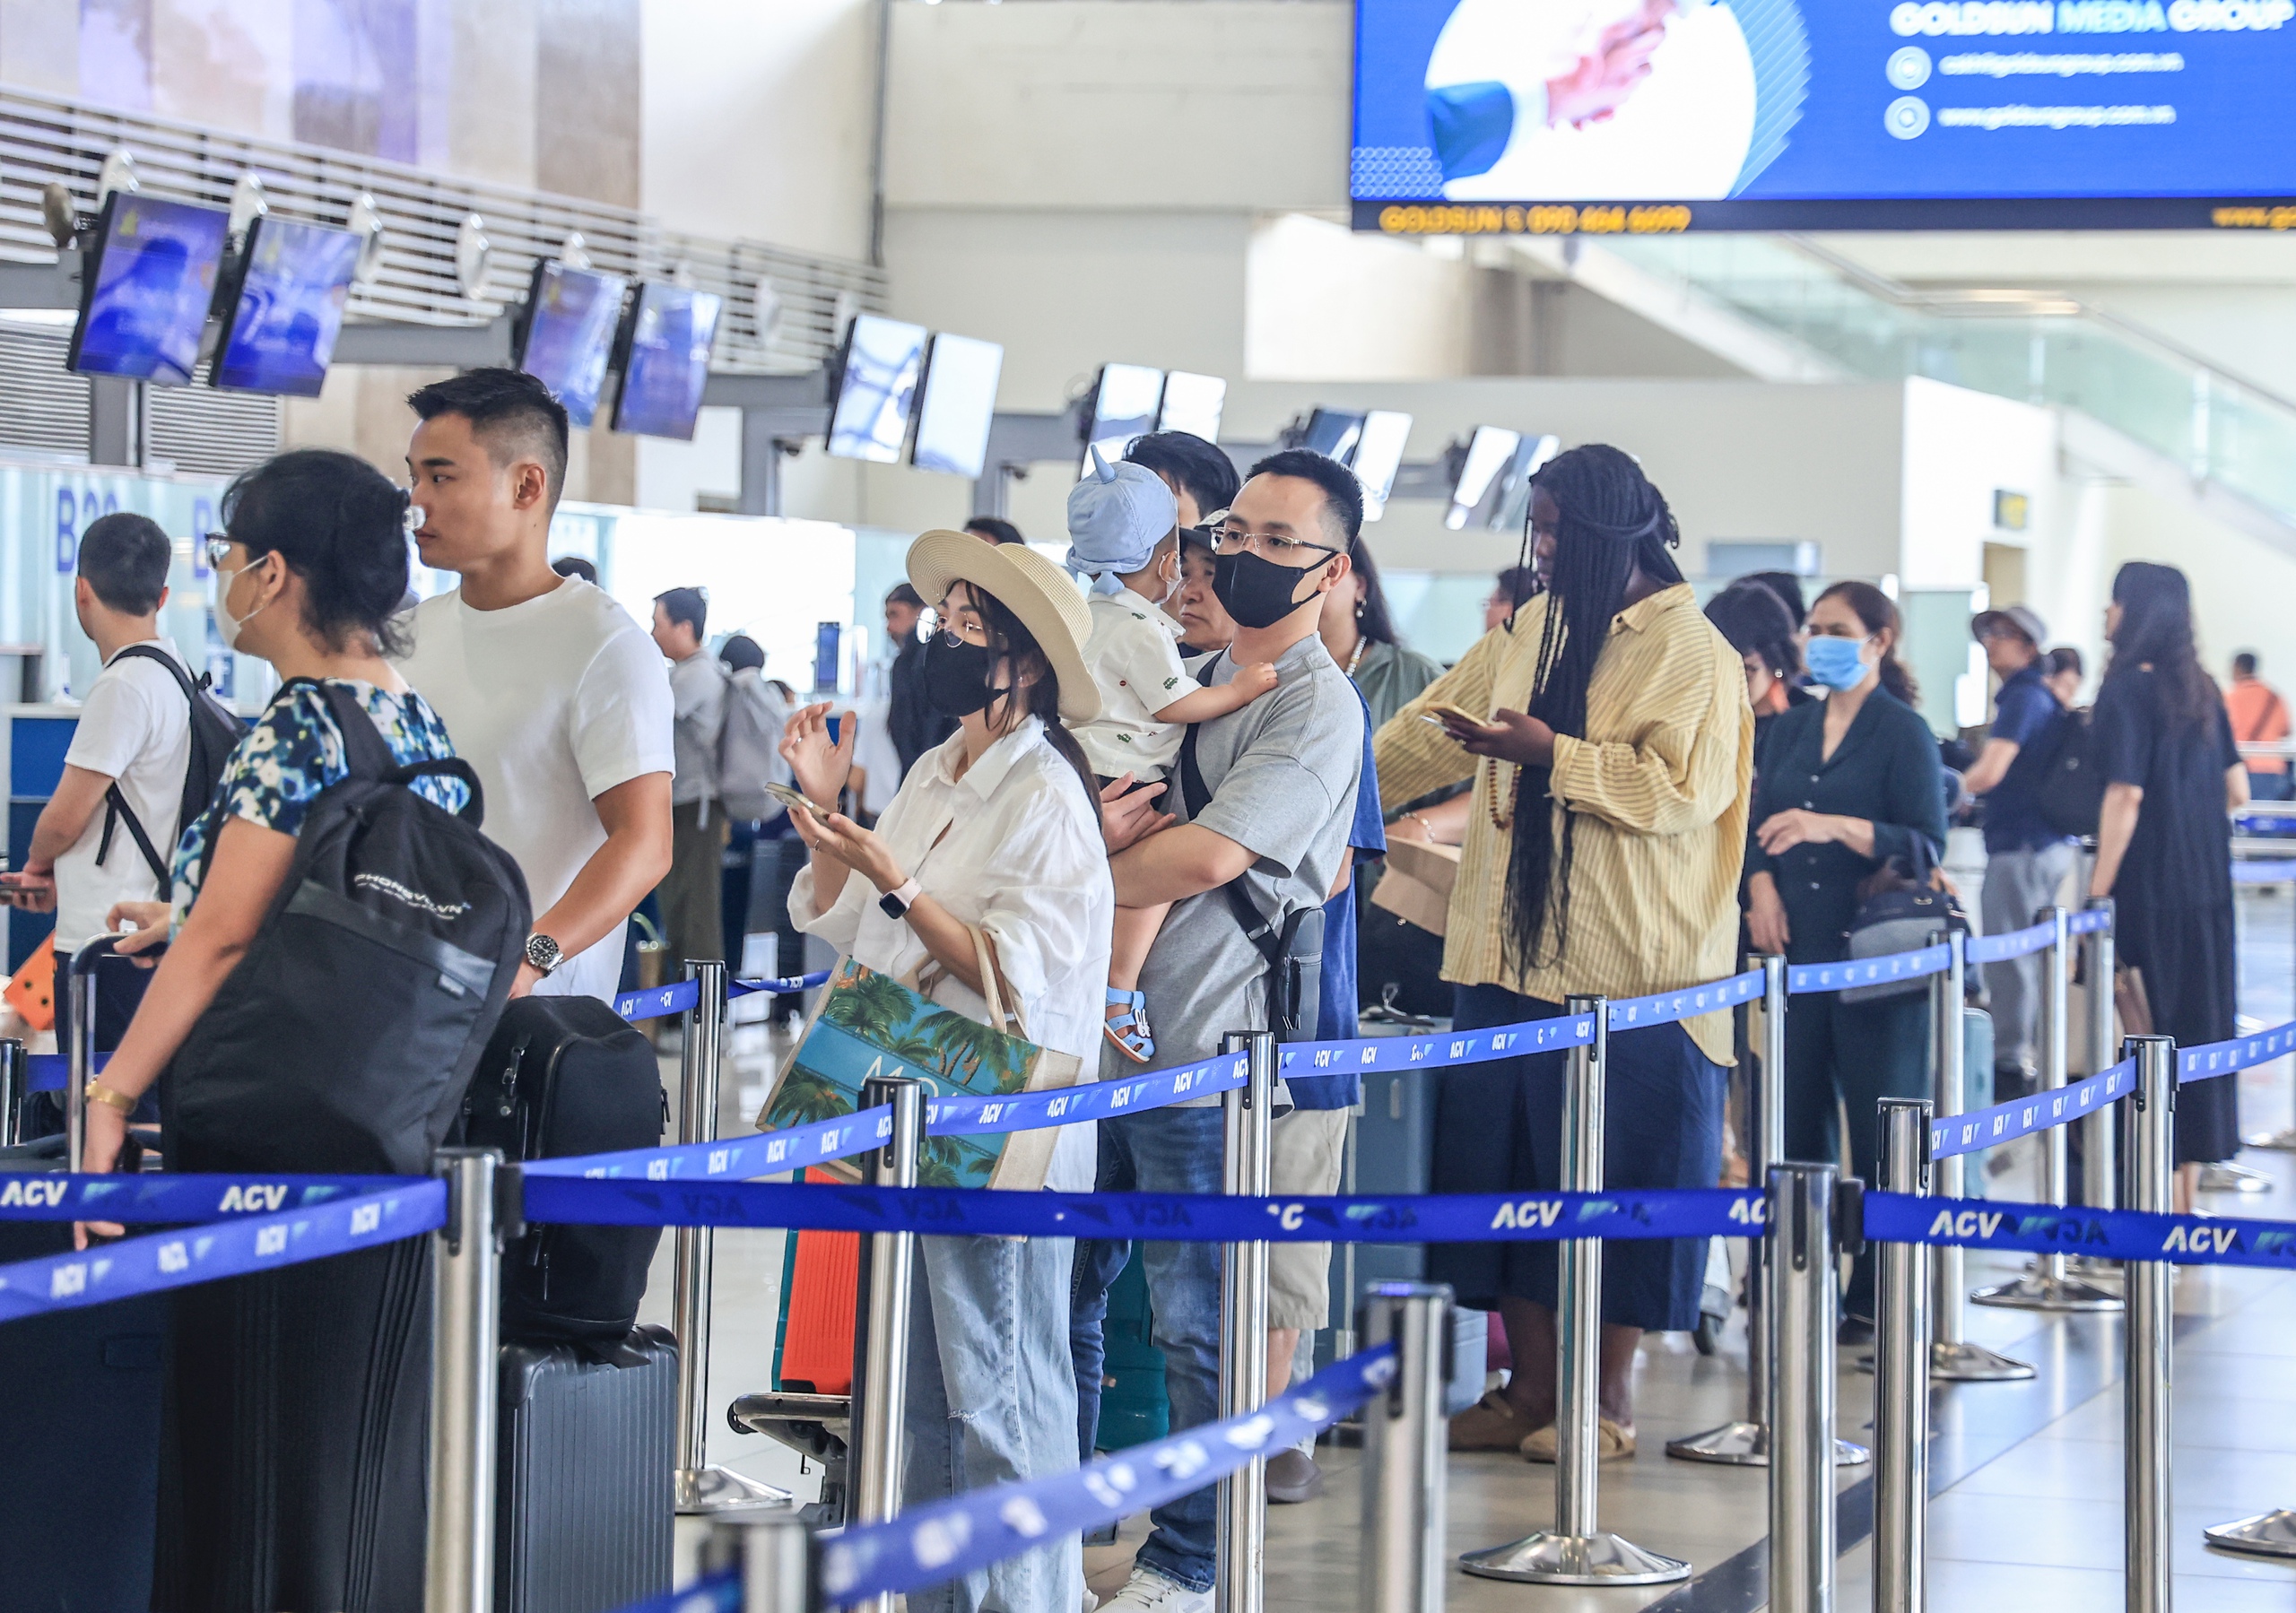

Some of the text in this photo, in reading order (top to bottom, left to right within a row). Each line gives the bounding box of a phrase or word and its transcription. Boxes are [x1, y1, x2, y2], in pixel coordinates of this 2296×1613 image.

[1361, 1046, 1378, 1064] ACV
[1449, 1040, 1465, 1059] ACV
[1492, 1033, 1508, 1051] ACV
[926, 1105, 939, 1125] CV
[978, 1104, 1003, 1124] ACV
[1047, 1096, 1069, 1117] ACV
[1110, 1086, 1131, 1108] ACV
[1173, 1071, 1194, 1094] ACV
[708, 1149, 728, 1175] ACV
[767, 1139, 786, 1163] ACV
[821, 1129, 839, 1155] ACV
[0, 1180, 288, 1211] ACV ACV
[1490, 1196, 1765, 1229] ACV AC
[1929, 1210, 2002, 1238] ACV
[2161, 1226, 2237, 1253] ACV
